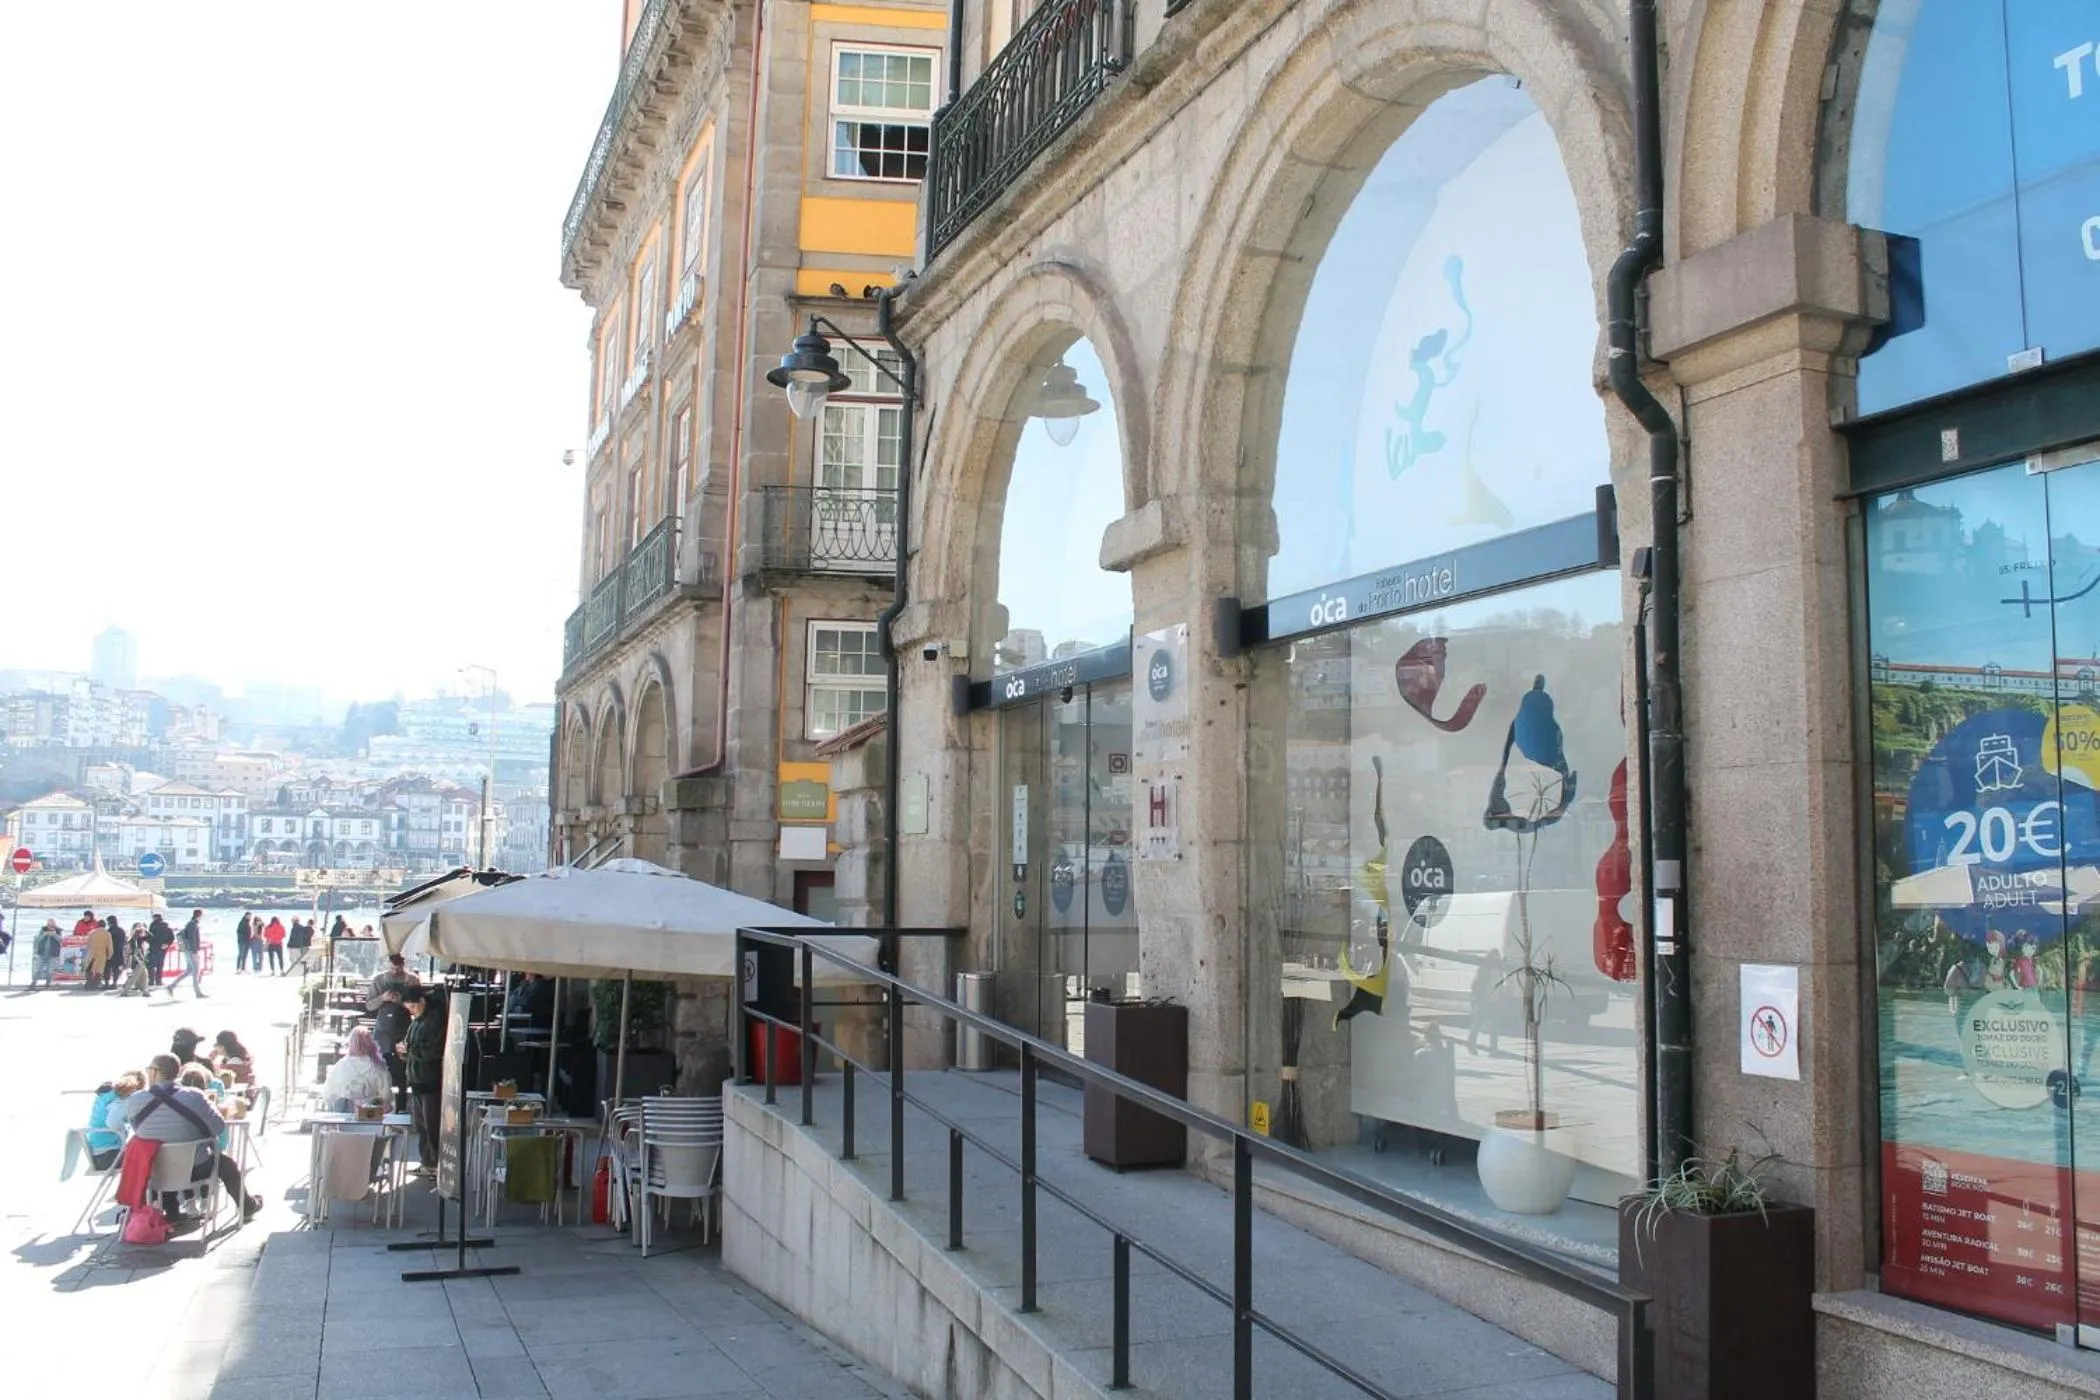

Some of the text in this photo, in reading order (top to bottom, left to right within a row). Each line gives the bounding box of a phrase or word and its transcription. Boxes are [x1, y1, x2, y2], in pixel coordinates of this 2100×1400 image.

[2053, 41, 2100, 98] T
[1404, 558, 1457, 602] hotel
[1943, 801, 2072, 866] 20€
[1977, 872, 2047, 893] ADULTO
[1983, 890, 2038, 909] ADULT
[1973, 1019, 2049, 1032] EXCLUSIVO
[1974, 1044, 2050, 1060] EXCLUSIVE
[1957, 1208, 1973, 1219] JET
[1973, 1211, 1997, 1222] BOAT
[1922, 1229, 1962, 1243] AVENTURA
[1964, 1237, 1999, 1251] RADICAL
[1952, 1259, 1967, 1270] JET
[1967, 1263, 1990, 1275] BOAT
